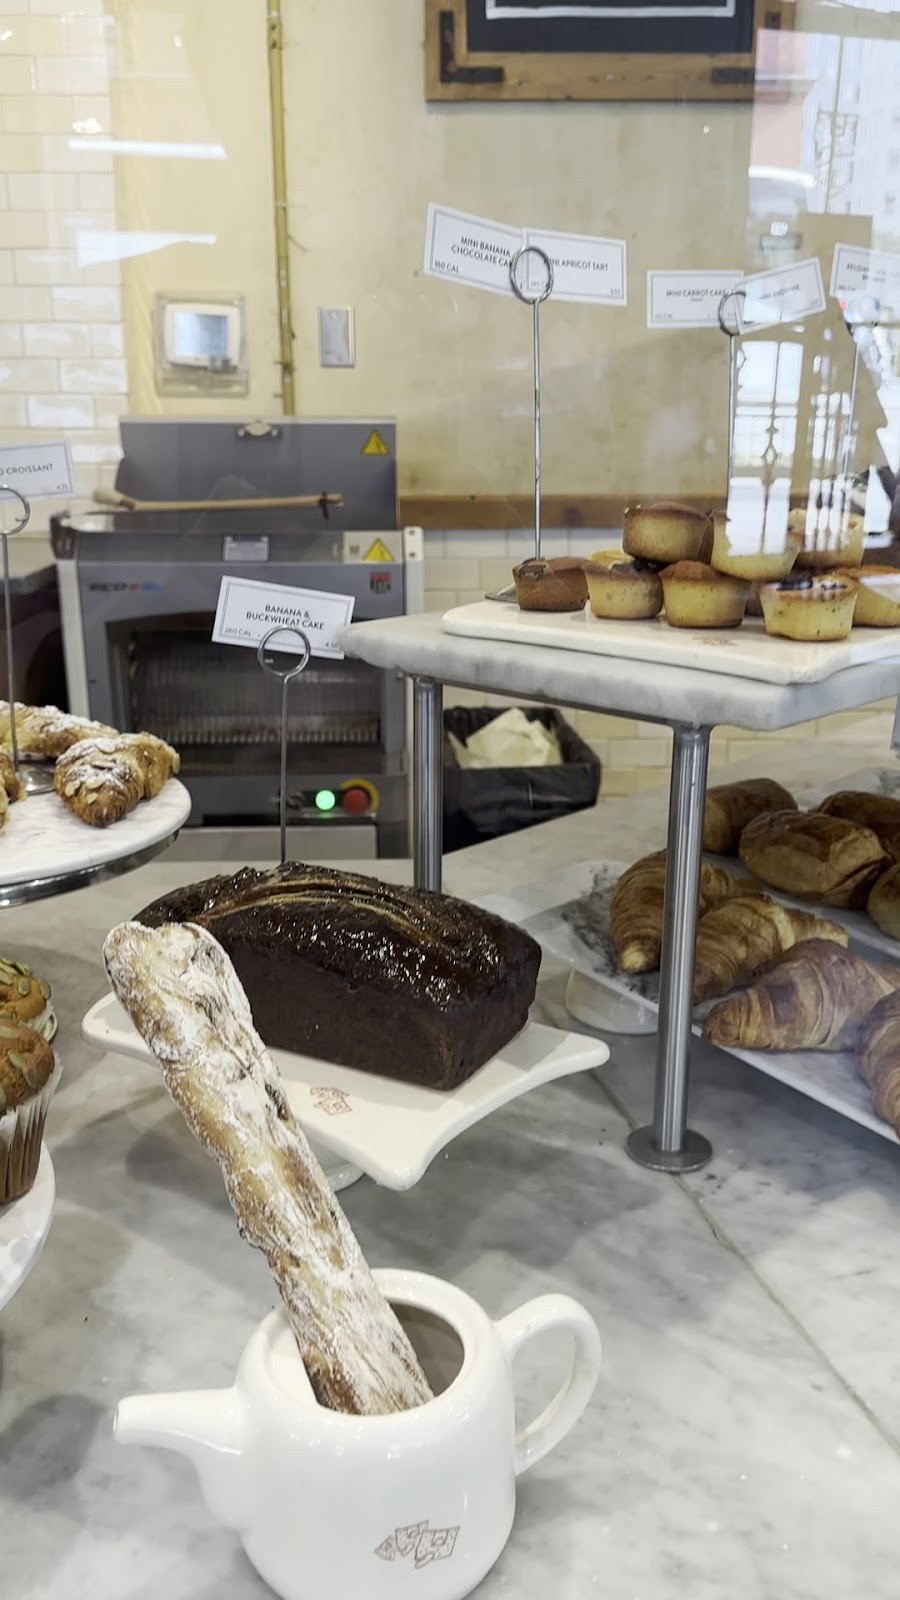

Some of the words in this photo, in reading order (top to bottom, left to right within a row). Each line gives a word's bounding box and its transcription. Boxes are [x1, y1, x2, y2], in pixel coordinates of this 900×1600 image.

[461, 236, 479, 249] MINI
[480, 240, 510, 258] BANANA
[451, 244, 497, 266] CHOCOLATE
[446, 263, 460, 274] CAL
[561, 260, 591, 270] APRICOT
[592, 263, 608, 272] TART
[6, 463, 53, 475] CROISSANT
[265, 604, 302, 617] BANANA
[303, 610, 310, 618] &
[246, 611, 300, 627] BUCKWHEAT
[301, 620, 325, 631] CAKE
[225, 626, 238, 634] 260
[238, 628, 252, 637] CAL
